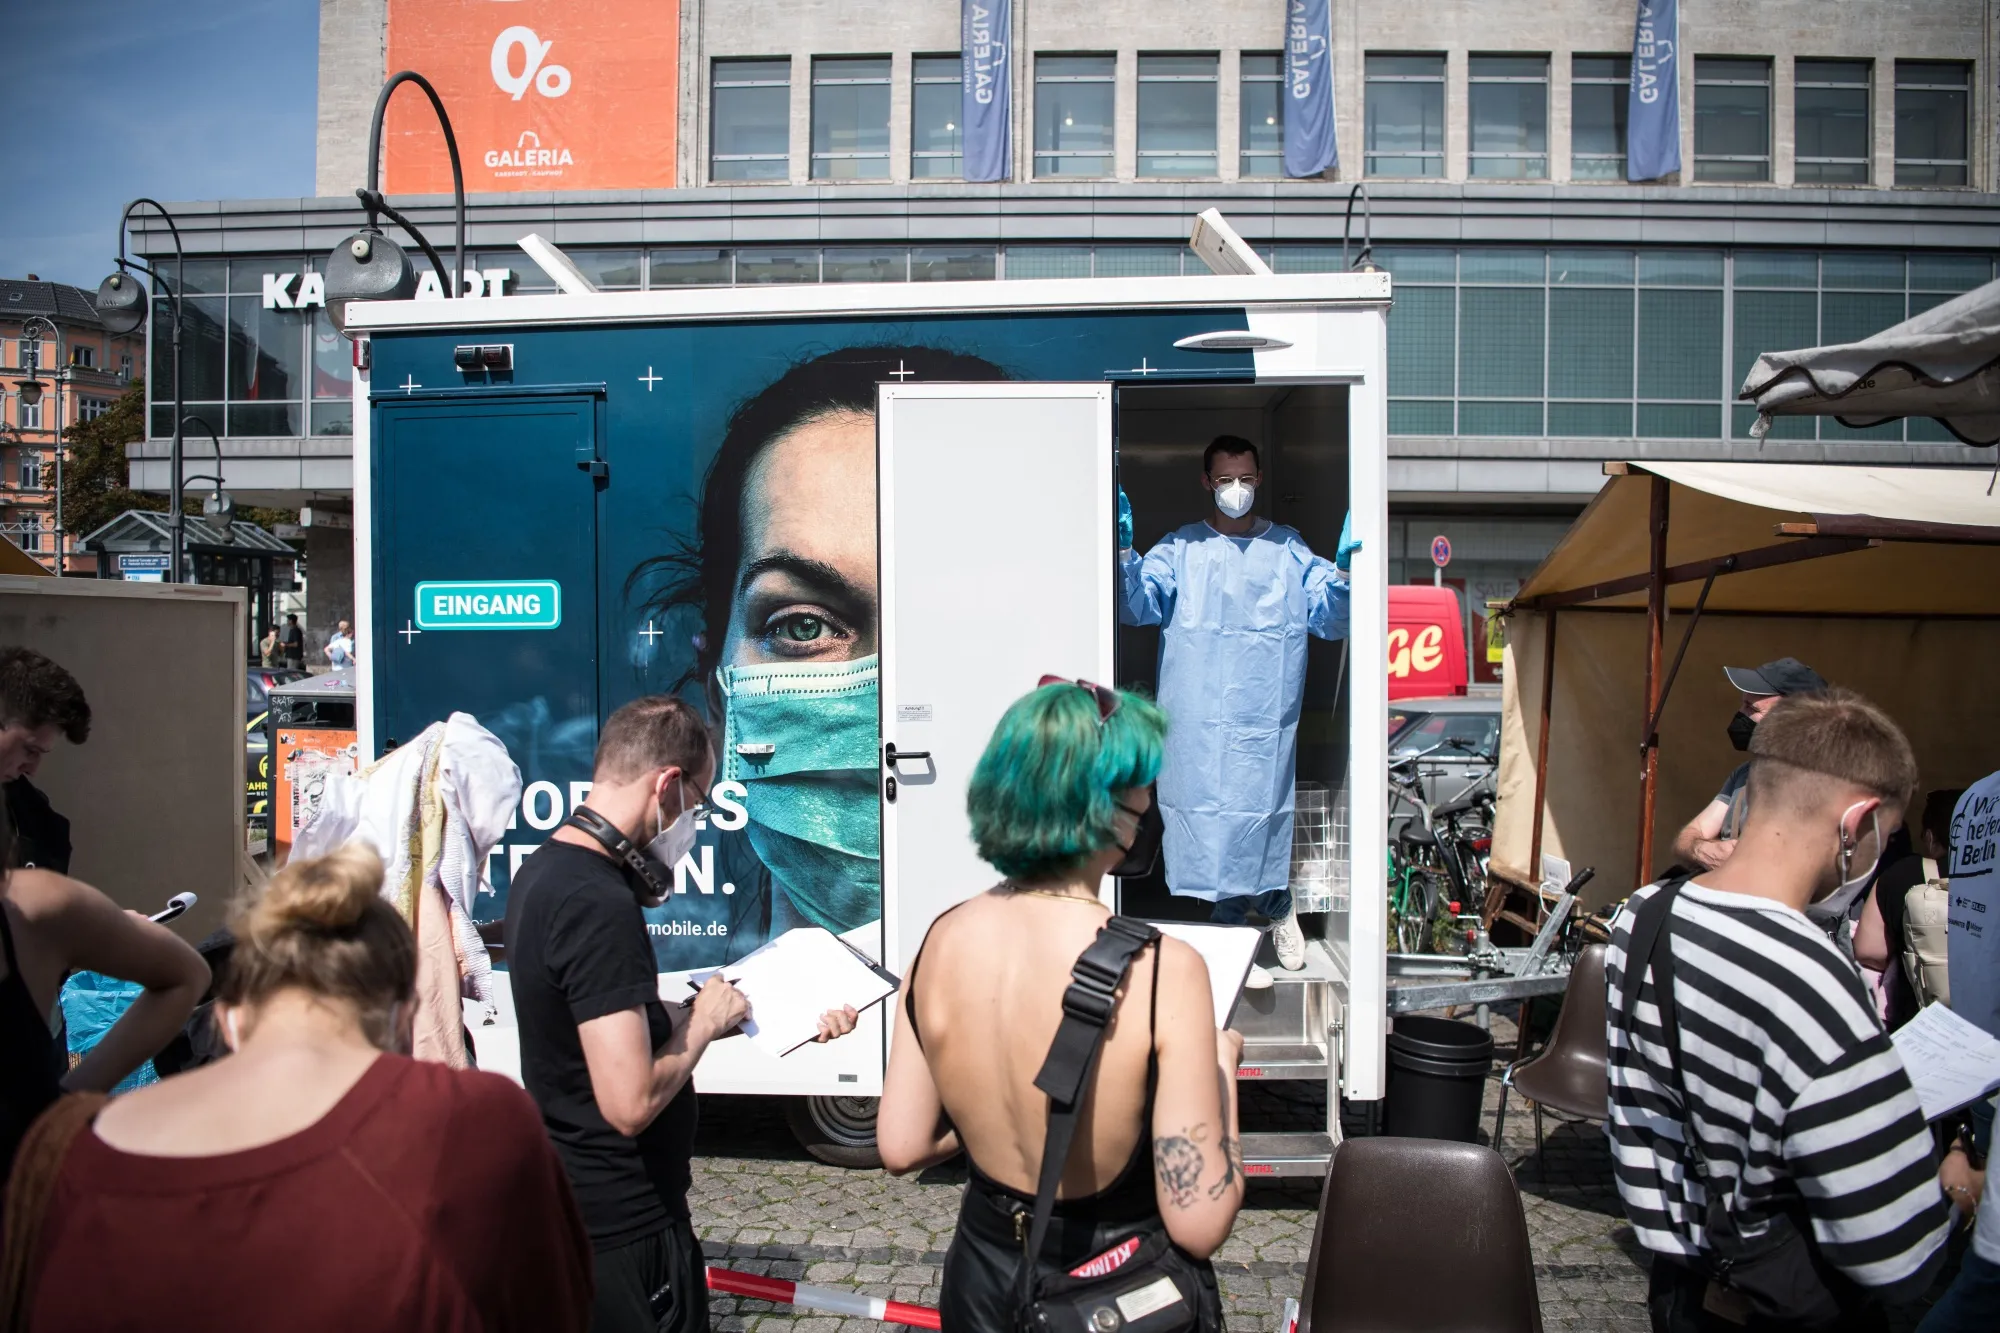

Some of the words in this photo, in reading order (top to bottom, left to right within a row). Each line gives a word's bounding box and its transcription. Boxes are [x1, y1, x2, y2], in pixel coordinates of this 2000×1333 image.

[484, 149, 574, 168] GALERIA
[263, 268, 510, 309] KAADT
[433, 594, 541, 616] EINGANG
